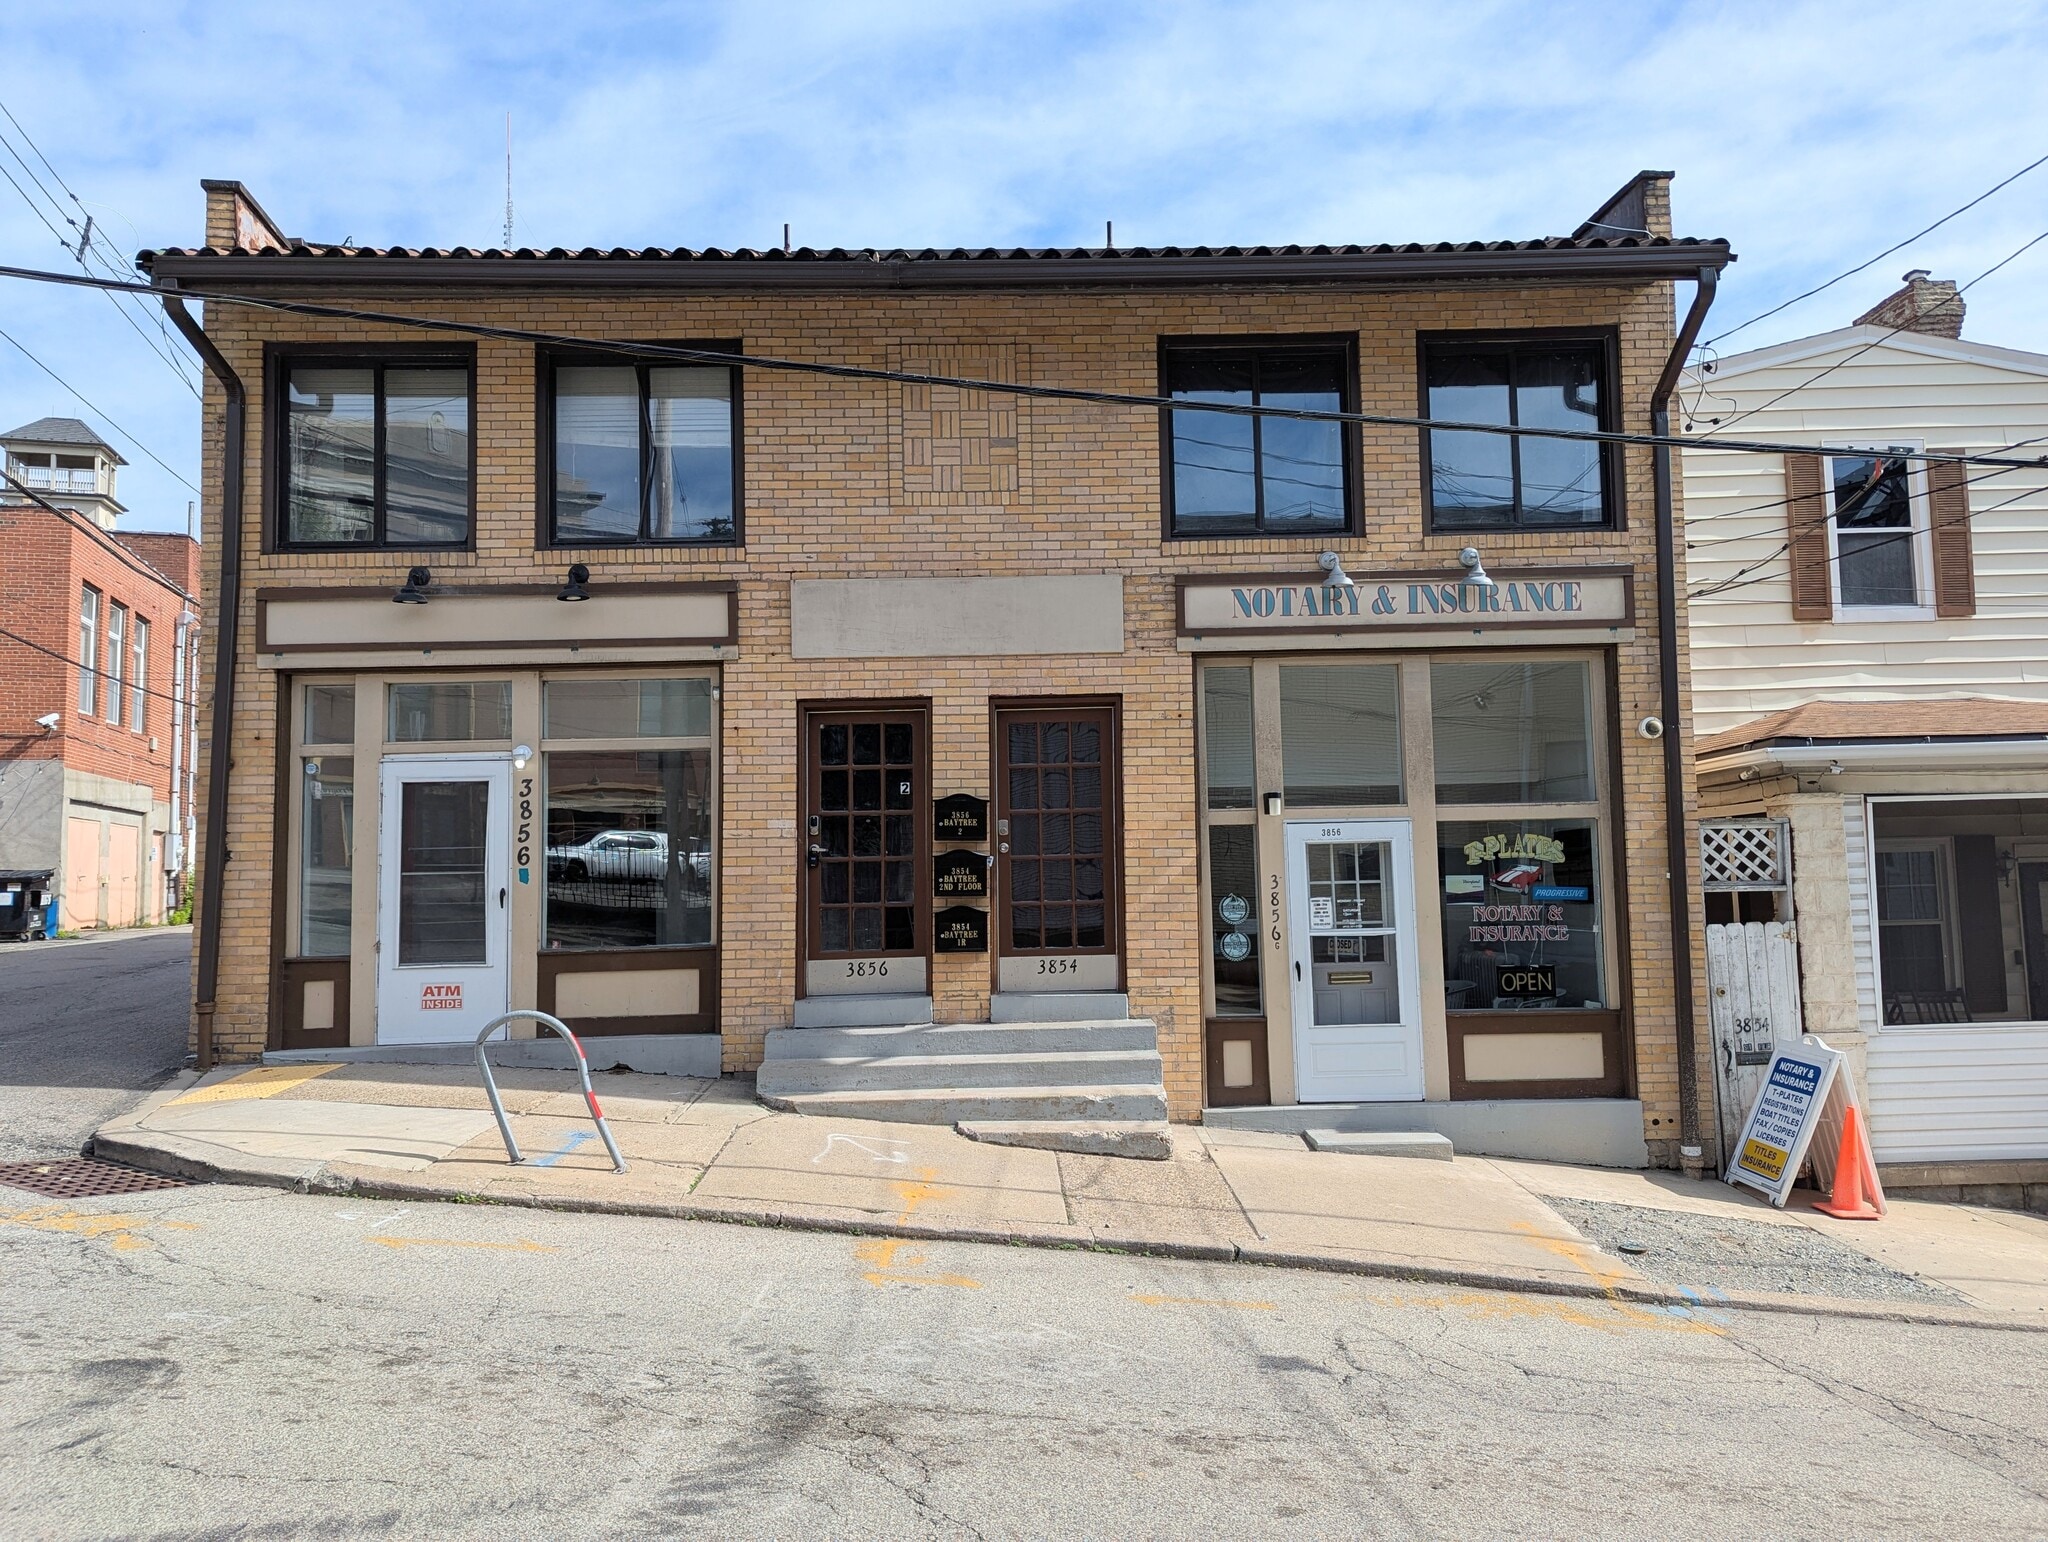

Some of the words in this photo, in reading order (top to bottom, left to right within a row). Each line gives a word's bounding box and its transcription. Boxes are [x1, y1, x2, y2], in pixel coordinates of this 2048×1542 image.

[1231, 585, 1365, 618] NOTARY
[1371, 584, 1398, 615] &
[1406, 581, 1582, 615] INSURANCE
[901, 783, 909, 794] 2
[517, 778, 533, 866] 3856
[944, 818, 978, 827] BAYTREE
[951, 811, 970, 819] 3856
[957, 827, 963, 836] 2
[1321, 828, 1341, 837] 3856
[944, 874, 978, 883] BAYTREE
[951, 867, 970, 875] 3854
[939, 882, 954, 891] 2ND
[958, 882, 982, 891] FLOOR
[1535, 888, 1586, 898] PROGRESSIVE
[1270, 874, 1282, 941] 3856
[1473, 905, 1543, 922] NOTARY
[1547, 904, 1564, 922] &
[944, 930, 979, 939] BAYTREE
[951, 922, 970, 931] 3854
[1469, 925, 1570, 942] INSURANCE
[1329, 939, 1352, 949] COSED
[845, 960, 888, 977] 3856
[1037, 958, 1078, 974] 3854
[1502, 972, 1552, 992] OPEN
[422, 985, 461, 997] ATM
[422, 999, 462, 1009] INSIDE
[1735, 1017, 1769, 1035] 3854
[1779, 1061, 1809, 1077] NOTARY
[1807, 1069, 1815, 1079] &
[1772, 1072, 1815, 1092] INSURANCE
[1772, 1088, 1804, 1104] T-PLATES
[1763, 1097, 1805, 1117] REGISTRATIONS
[1760, 1107, 1778, 1120] BOAT
[1777, 1113, 1800, 1127] TITLES
[1755, 1118, 1768, 1129] FAX
[1772, 1124, 1797, 1138] COPIES
[1755, 1130, 1788, 1147] LICENSES
[1753, 1145, 1778, 1161] TITLES
[1741, 1154, 1782, 1175] INSURANCE
